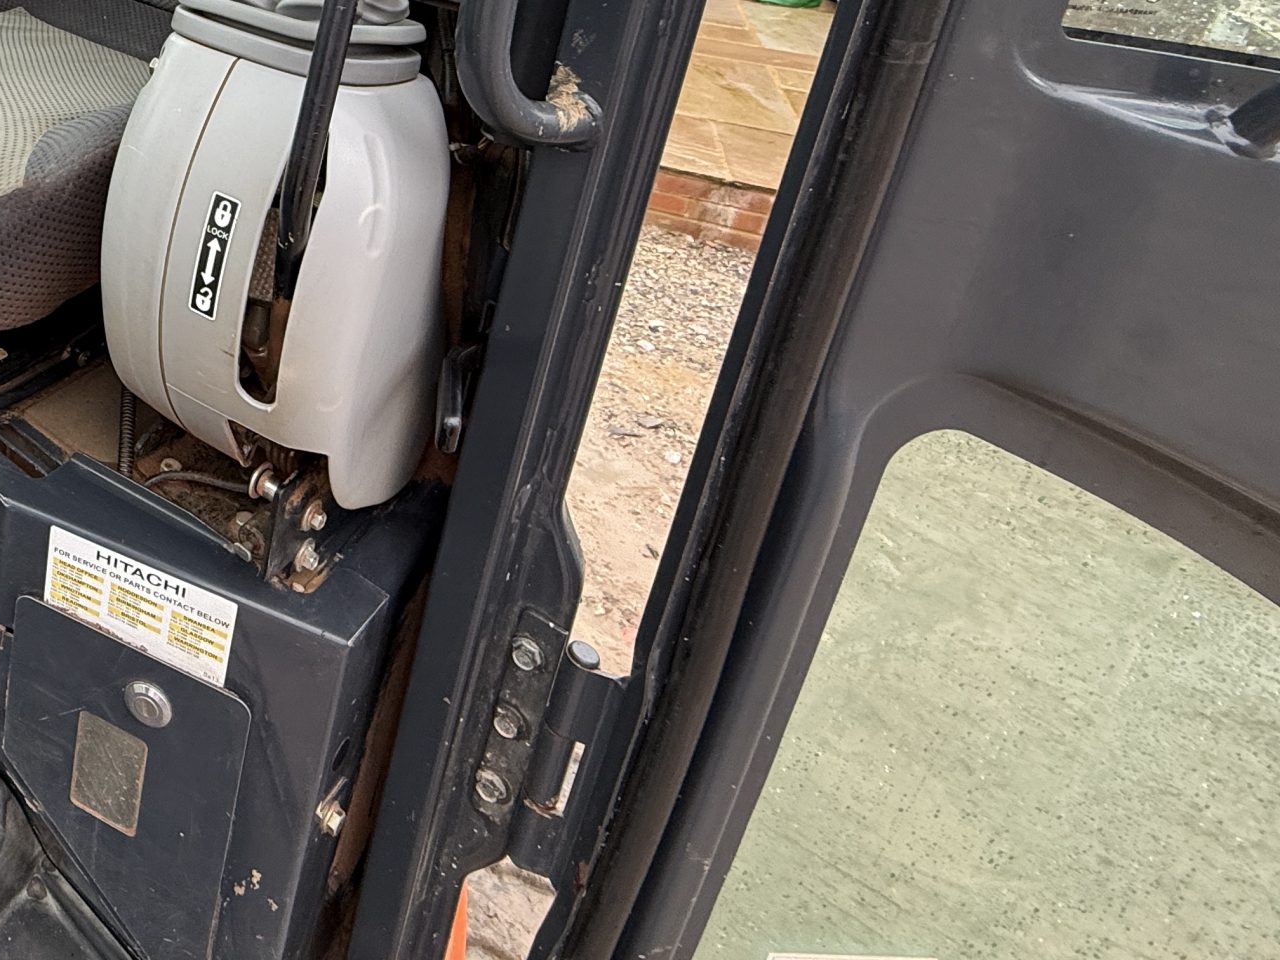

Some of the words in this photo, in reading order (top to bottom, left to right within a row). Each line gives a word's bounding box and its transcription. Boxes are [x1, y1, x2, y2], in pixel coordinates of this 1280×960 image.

[206, 225, 229, 240] LOCK
[59, 559, 76, 570] HEAD
[77, 567, 98, 580] OFFICE
[96, 550, 186, 598] HITACHI
[54, 546, 70, 559] FOR
[72, 555, 107, 574] SERVICE
[109, 572, 121, 581] OR
[124, 578, 151, 594] PARTS
[153, 591, 195, 613] CONTACT
[197, 610, 230, 628] BELOW
[57, 570, 98, 592] OKEHAMPTON
[60, 584, 92, 600] WROTHAM
[117, 586, 158, 607] HODDESDON
[61, 596, 88, 611] READING
[116, 597, 156, 619] BIRMINGHAM
[120, 611, 147, 627] BRISTOL
[183, 615, 215, 633] SWANSEA
[180, 627, 214, 645] GLASGOW
[173, 637, 218, 660] WARRINGTON
